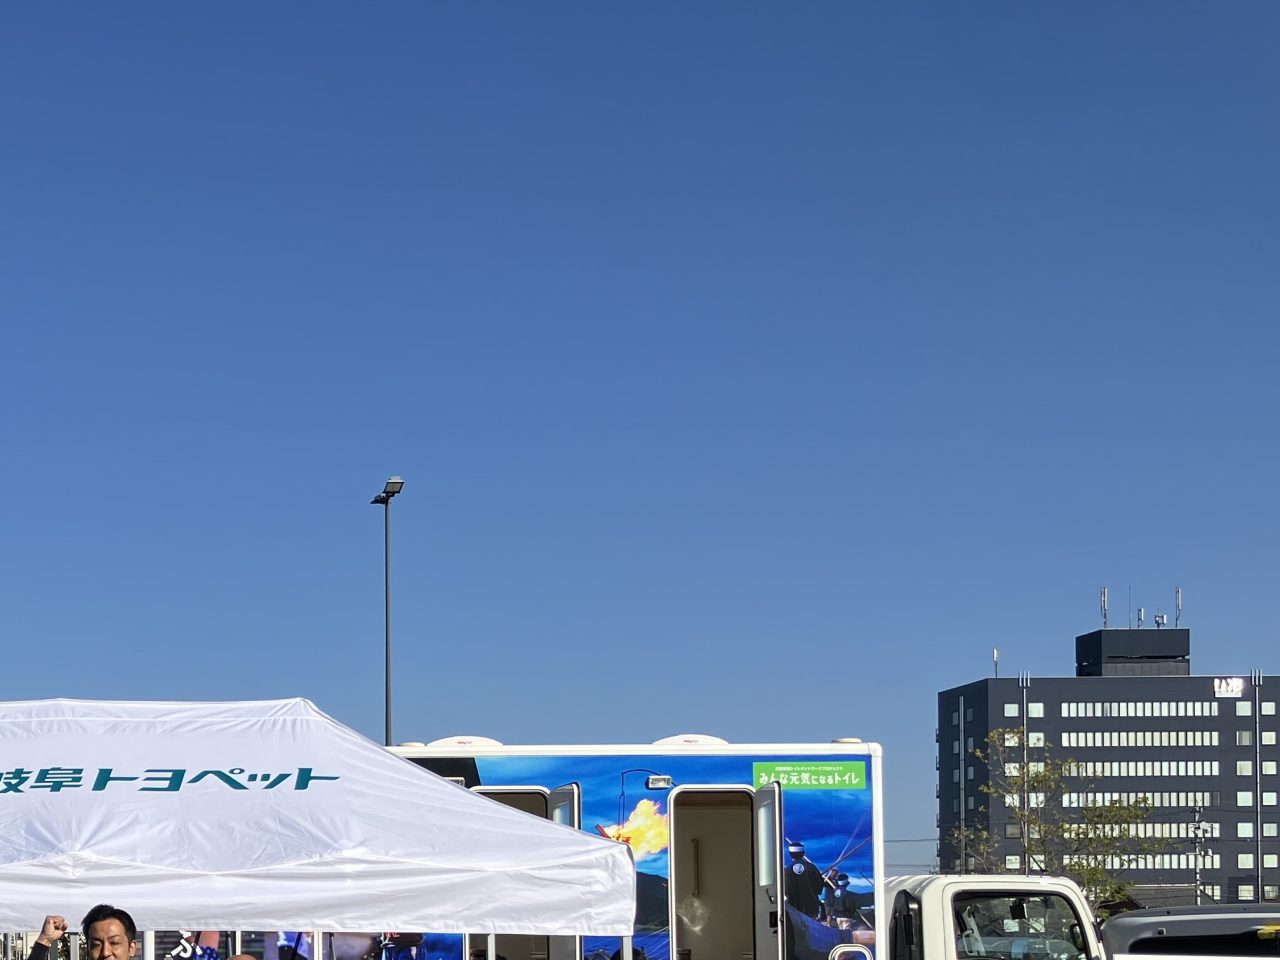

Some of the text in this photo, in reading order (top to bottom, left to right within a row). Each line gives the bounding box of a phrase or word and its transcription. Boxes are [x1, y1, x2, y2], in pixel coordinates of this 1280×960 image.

[759, 772, 860, 785] みんな元気になるトイレ
